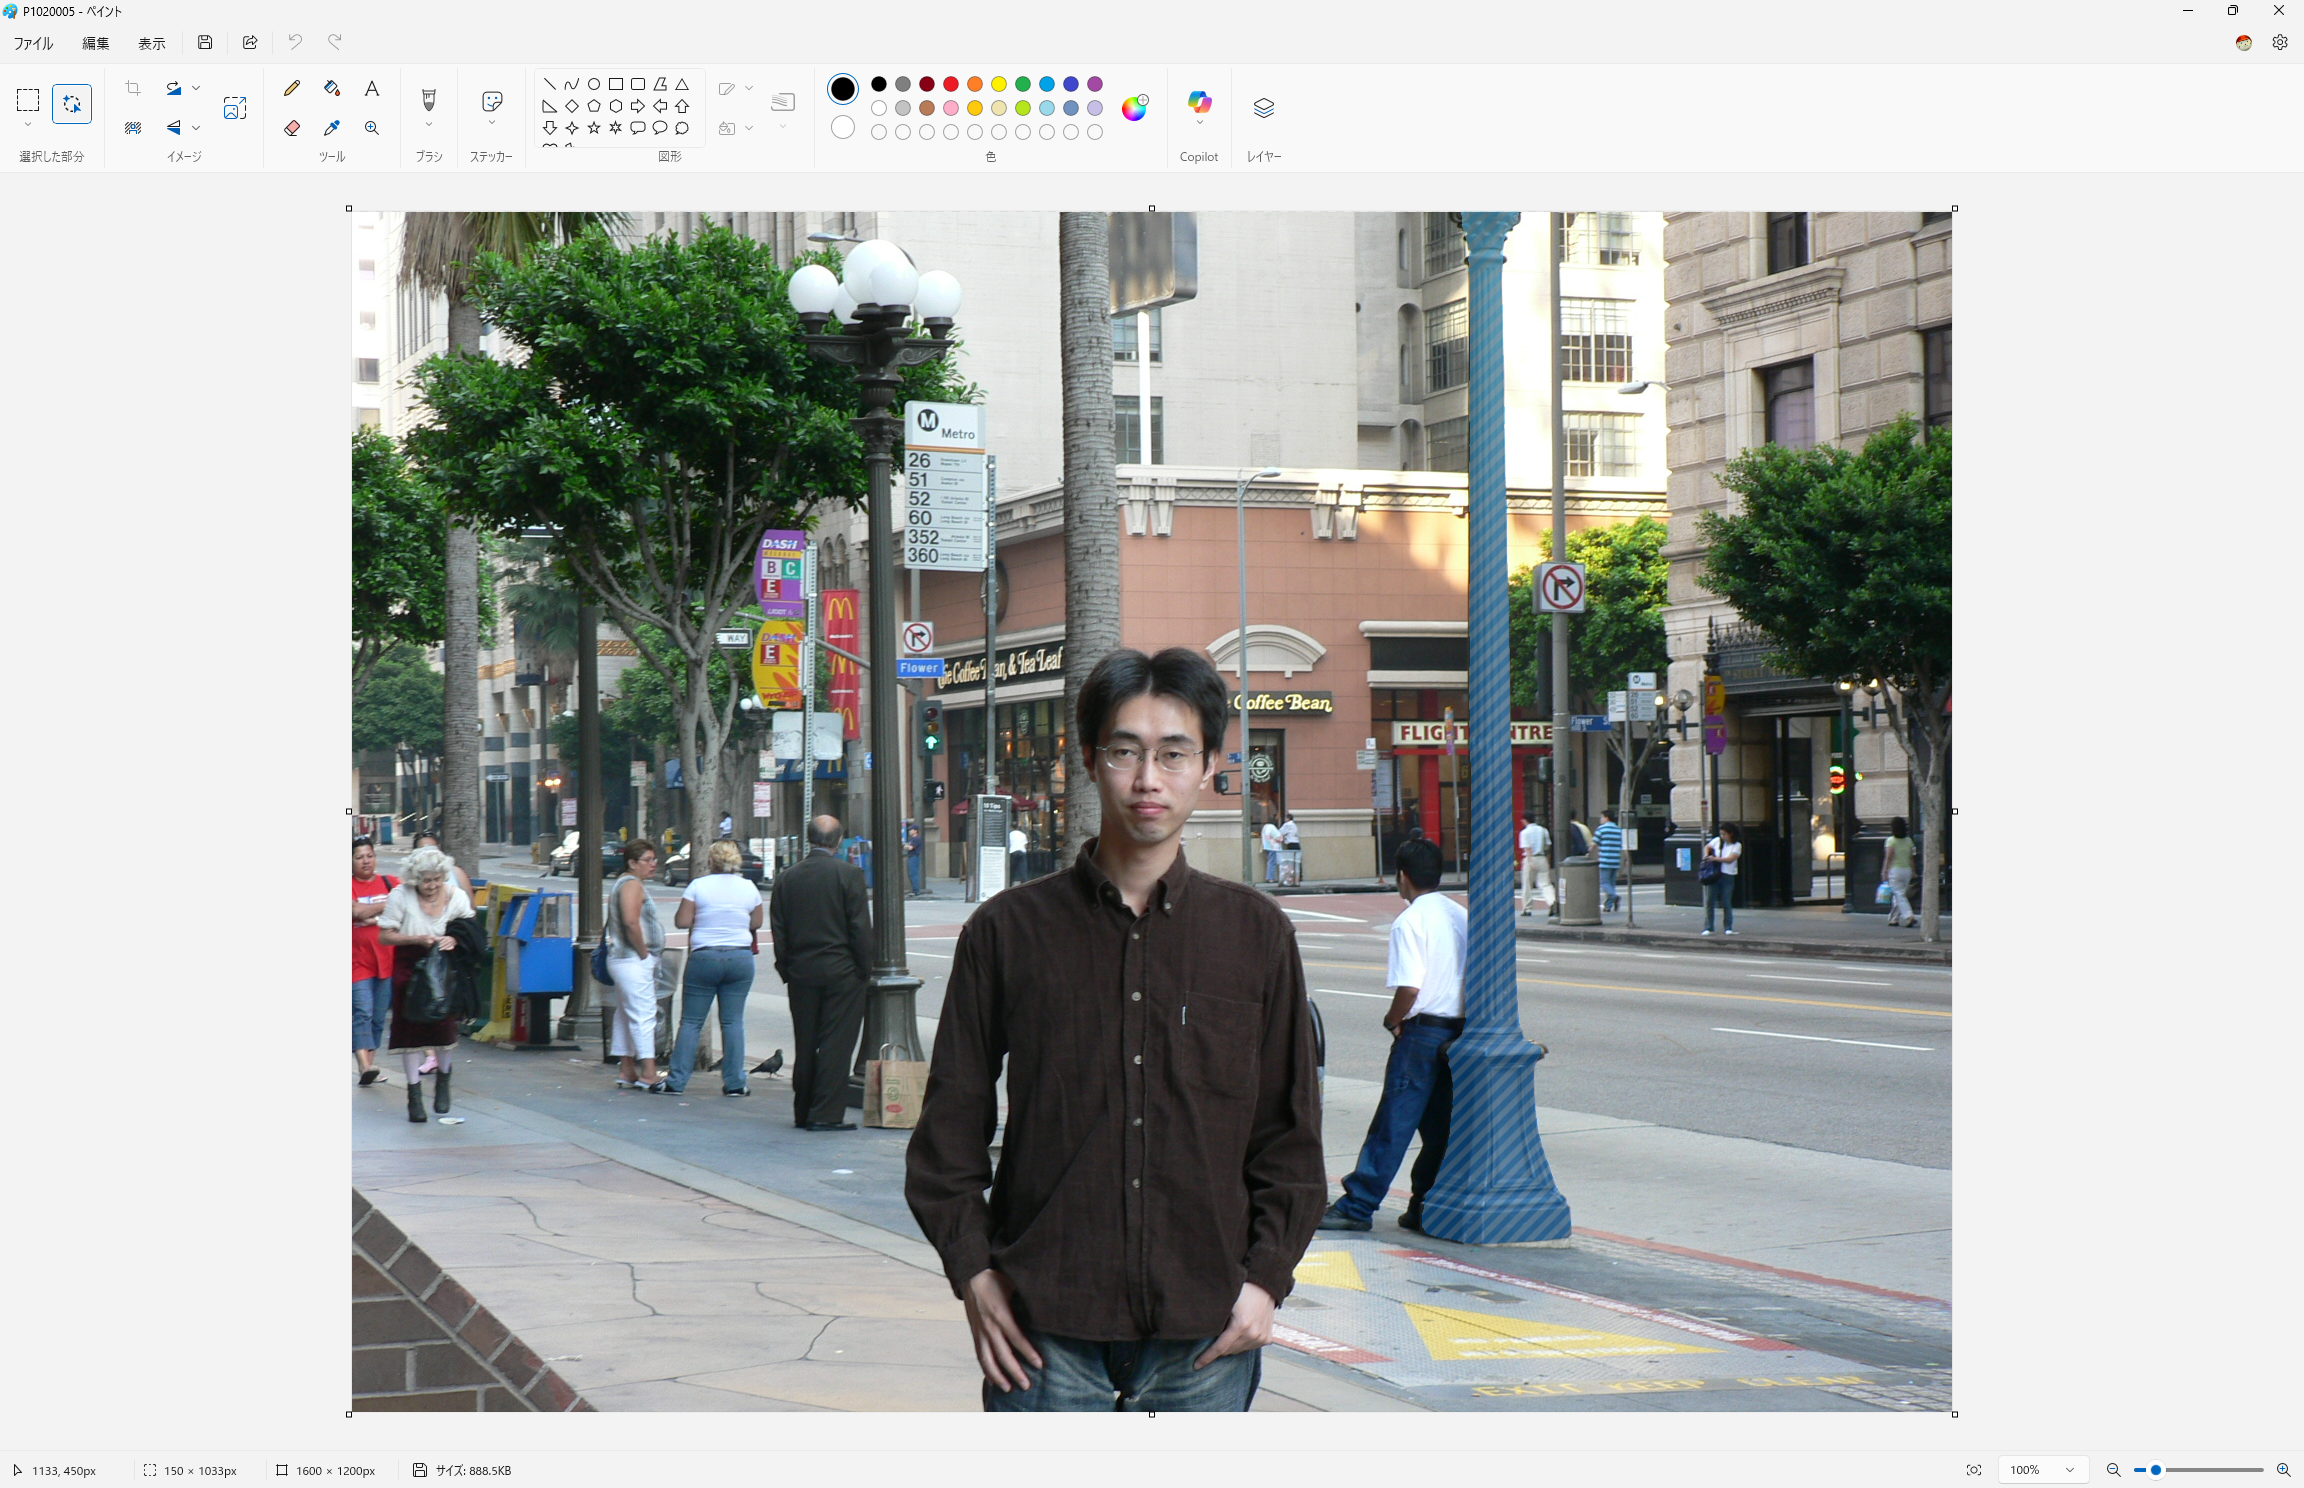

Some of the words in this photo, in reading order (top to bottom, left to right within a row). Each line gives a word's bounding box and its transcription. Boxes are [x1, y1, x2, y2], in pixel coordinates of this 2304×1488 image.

[24, 6, 76, 17] P1020005
[87, 6, 122, 18] ペイント
[14, 36, 54, 51] ファイル
[82, 36, 110, 51] 編集
[138, 36, 166, 51] 表示
[18, 150, 85, 163] 選択した部分
[168, 150, 202, 163] イメージ
[319, 150, 346, 163] ツール
[416, 149, 443, 163] ブラシ
[470, 150, 513, 163] ステッカー
[659, 150, 683, 163] 図形
[985, 150, 997, 163] 色
[1180, 151, 1219, 165] Copilot
[1247, 150, 1282, 163] レイヤー
[941, 428, 976, 440] Metro
[909, 452, 931, 468] 26
[909, 472, 928, 487] 51
[909, 491, 931, 506] 52
[908, 510, 932, 526] 60
[908, 528, 940, 545] 352
[762, 538, 798, 550] DASH
[908, 548, 939, 563] 360
[767, 561, 776, 574] B
[785, 561, 796, 575] C
[766, 579, 776, 593] E
[727, 634, 746, 643] WAY
[761, 633, 797, 643] DASH
[765, 645, 776, 659] E
[900, 662, 939, 674] Flower
[953, 660, 981, 684] Coffee
[980, 657, 1007, 681] Ban
[1007, 653, 1018, 676] &
[1017, 650, 1036, 675] Tea
[1036, 646, 1064, 671] Leaf
[1233, 694, 1284, 710] Coffee
[1284, 694, 1333, 713] Bean
[1571, 716, 1594, 725] Flower
[1472, 1383, 1584, 1397] EXIT
[1601, 1379, 1706, 1391] KEEP
[1736, 1375, 1876, 1387] CLEAR
[32, 1466, 60, 1478] 1133,
[62, 1466, 97, 1479] 450px
[164, 1466, 184, 1476] 150
[198, 1466, 237, 1479] 1033px
[296, 1466, 323, 1476] 1600
[337, 1466, 376, 1479] 1200px
[436, 1464, 466, 1477] サイズ:
[469, 1465, 512, 1476] 888.5KB
[2010, 1464, 2040, 1476] 100%
